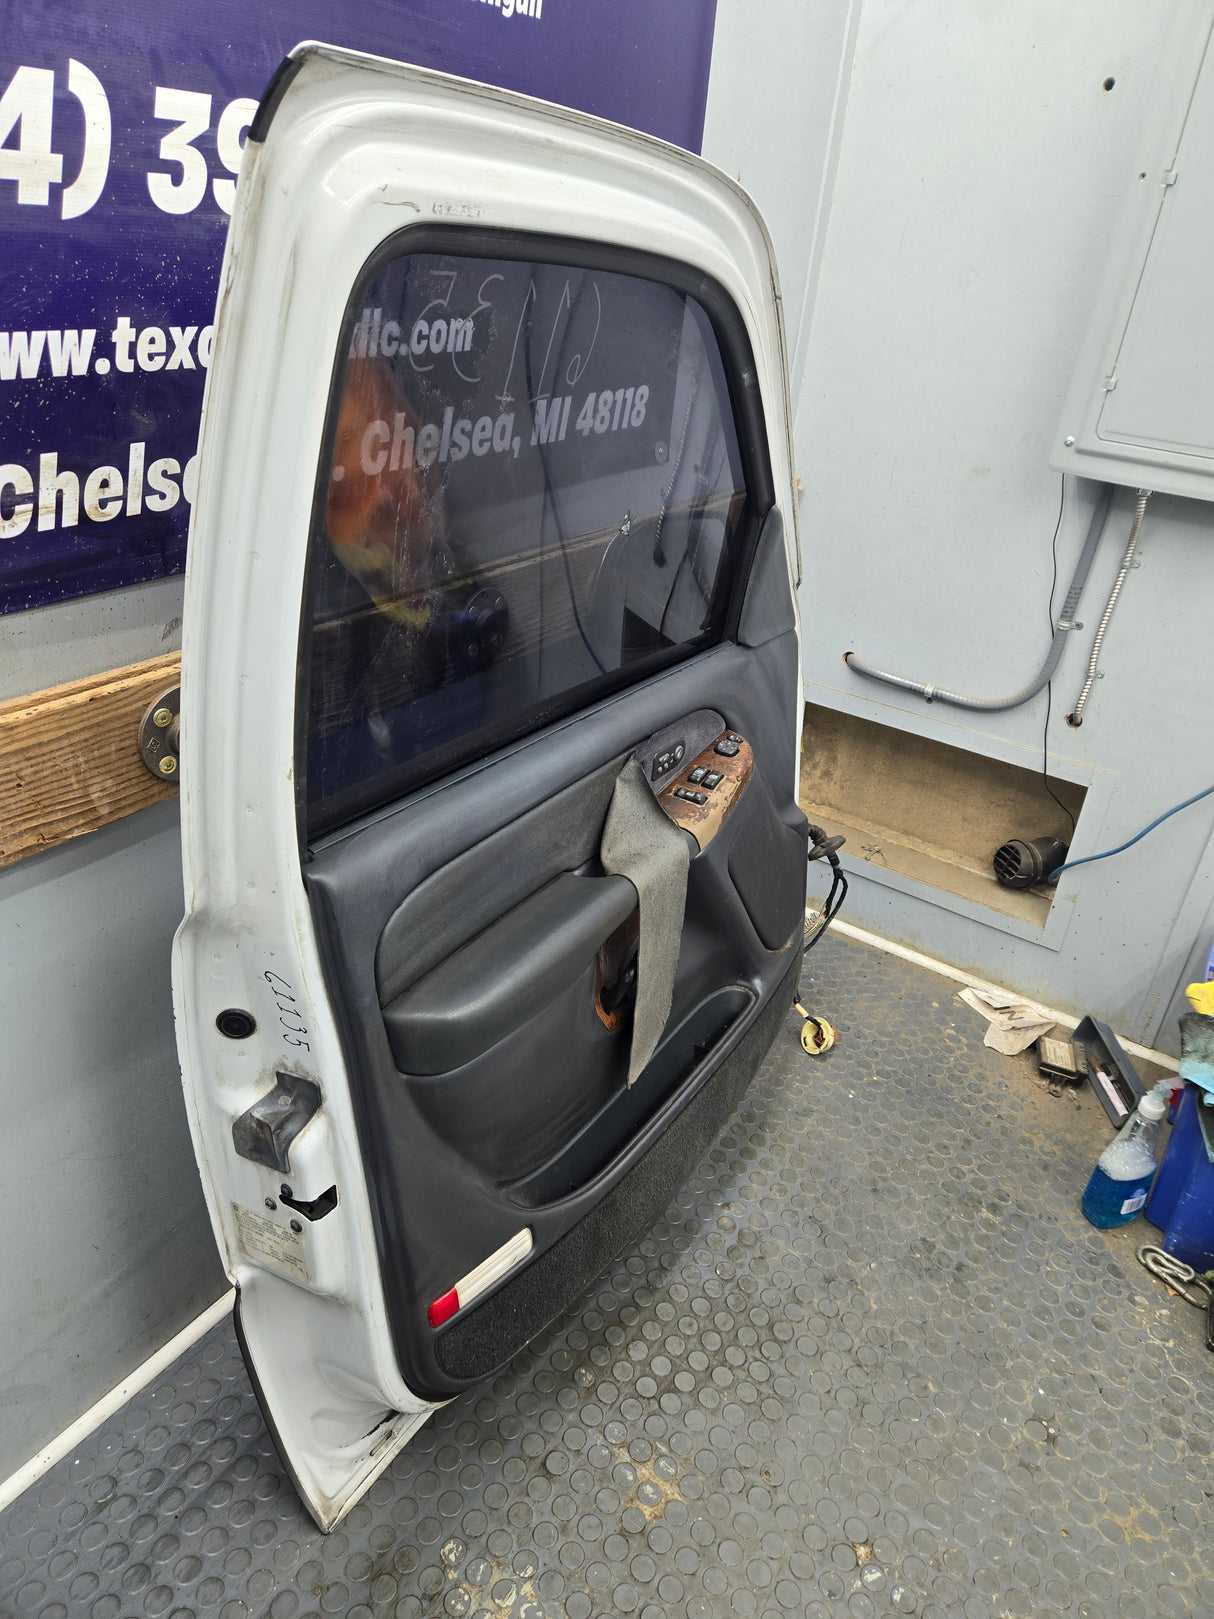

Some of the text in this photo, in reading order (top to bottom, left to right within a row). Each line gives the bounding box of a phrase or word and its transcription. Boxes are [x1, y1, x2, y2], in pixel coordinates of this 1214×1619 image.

[361, 384, 650, 476] Chelsea, MI 48118
[264, 971, 310, 1052] 61135
